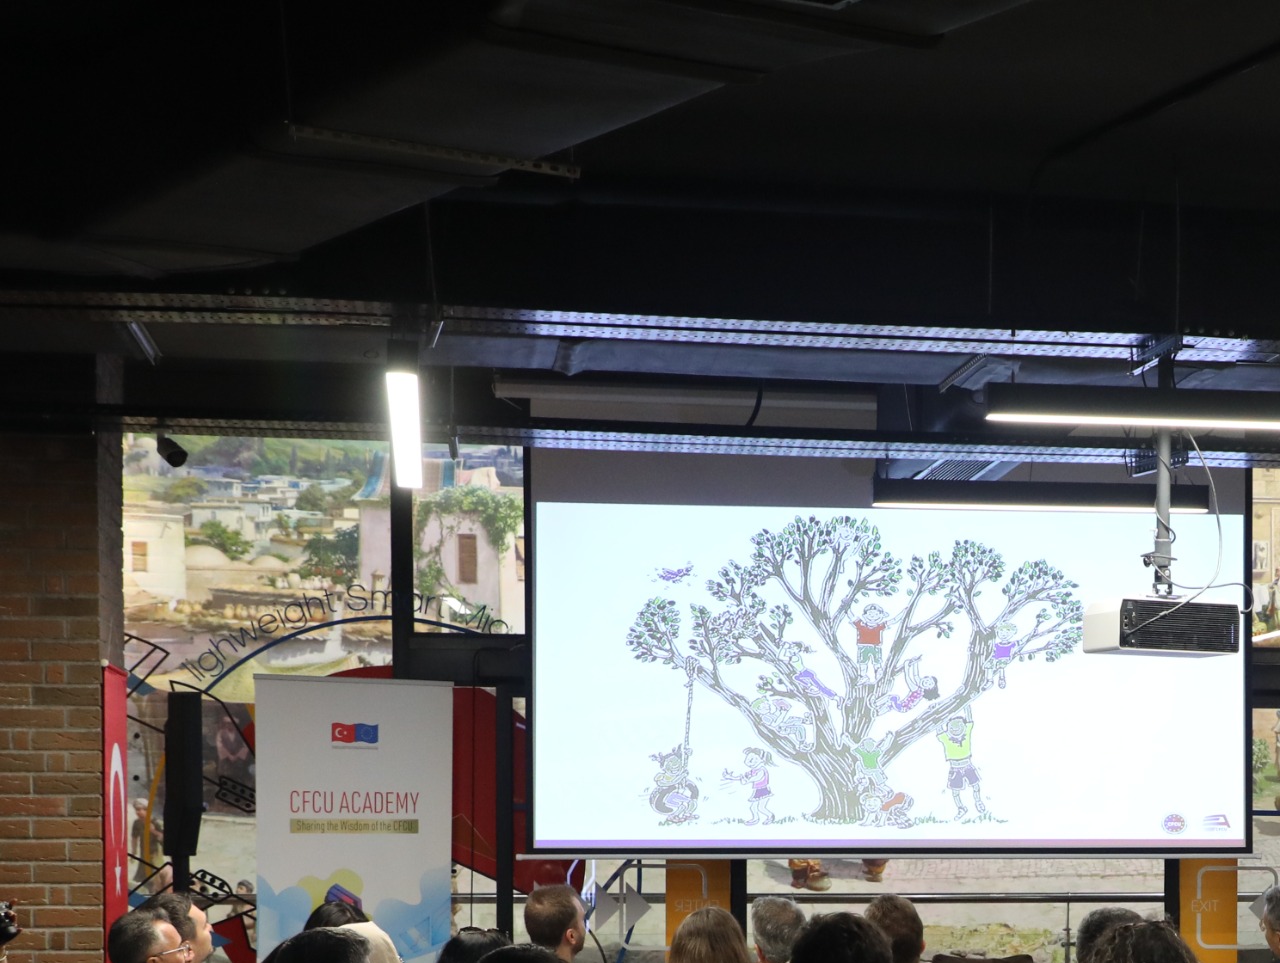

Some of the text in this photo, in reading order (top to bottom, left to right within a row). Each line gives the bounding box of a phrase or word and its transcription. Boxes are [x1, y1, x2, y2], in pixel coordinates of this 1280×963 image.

[289, 790, 420, 814] CFCU ACADEMY
[296, 820, 413, 833] Sharing the Wisdom of the CFCU
[1191, 900, 1219, 912] EXIT
